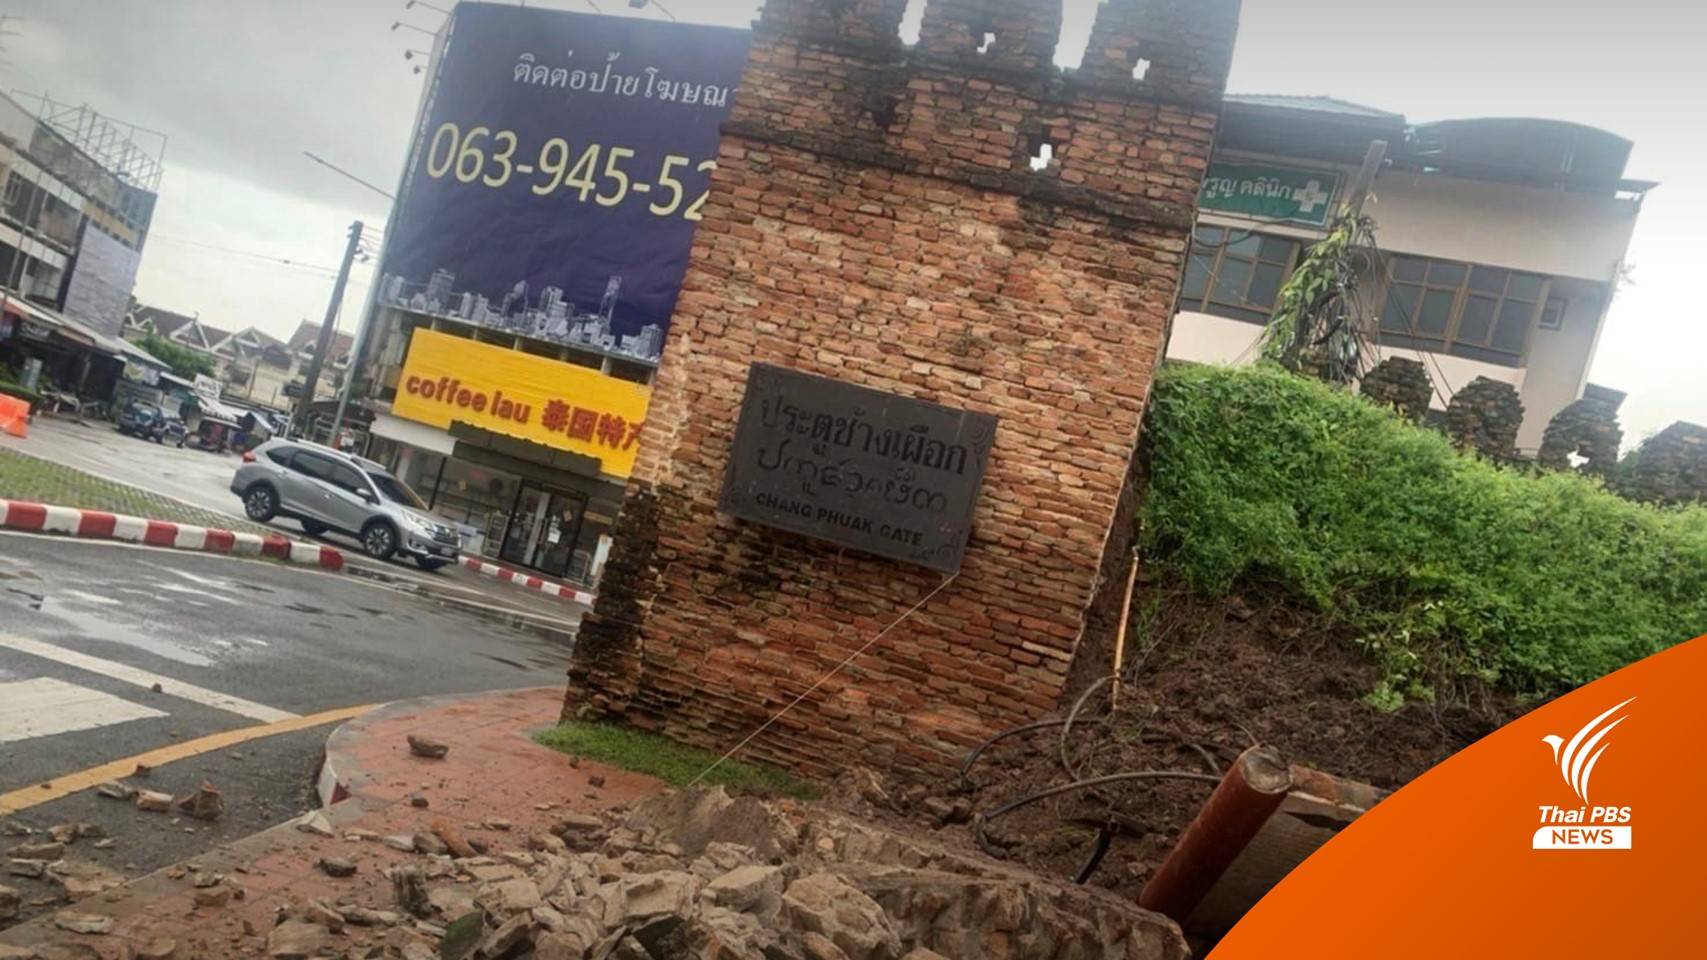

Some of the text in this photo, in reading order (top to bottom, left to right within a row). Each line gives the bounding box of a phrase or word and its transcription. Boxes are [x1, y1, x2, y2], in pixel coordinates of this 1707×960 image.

[406, 374, 487, 413] coffee
[491, 390, 531, 424] lau
[761, 396, 968, 475] ประตูช้างเผือก
[756, 493, 923, 546] CHANG PHUAK GATE
